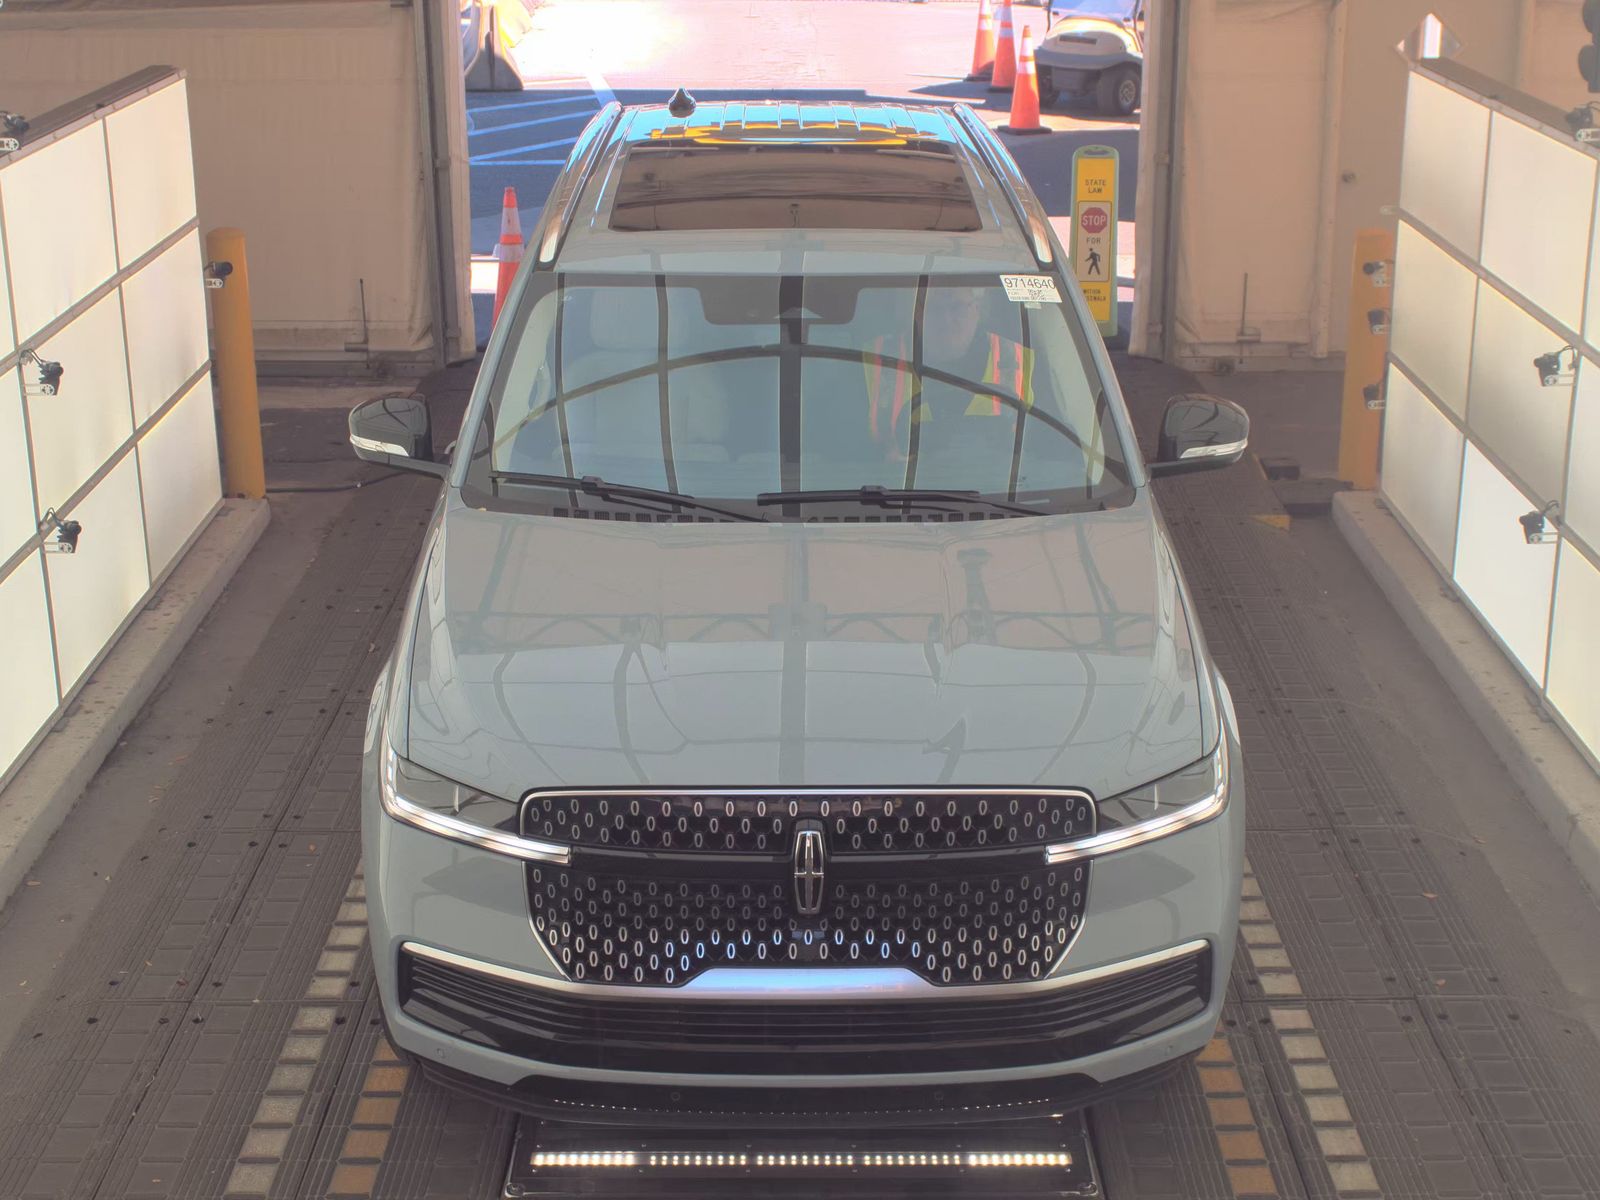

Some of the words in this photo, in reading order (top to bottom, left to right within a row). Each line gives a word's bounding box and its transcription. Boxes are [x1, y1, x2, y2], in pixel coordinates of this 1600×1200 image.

[1085, 178, 1107, 186] STATE
[1082, 215, 1107, 226] STOP
[1086, 236, 1101, 244] FOR
